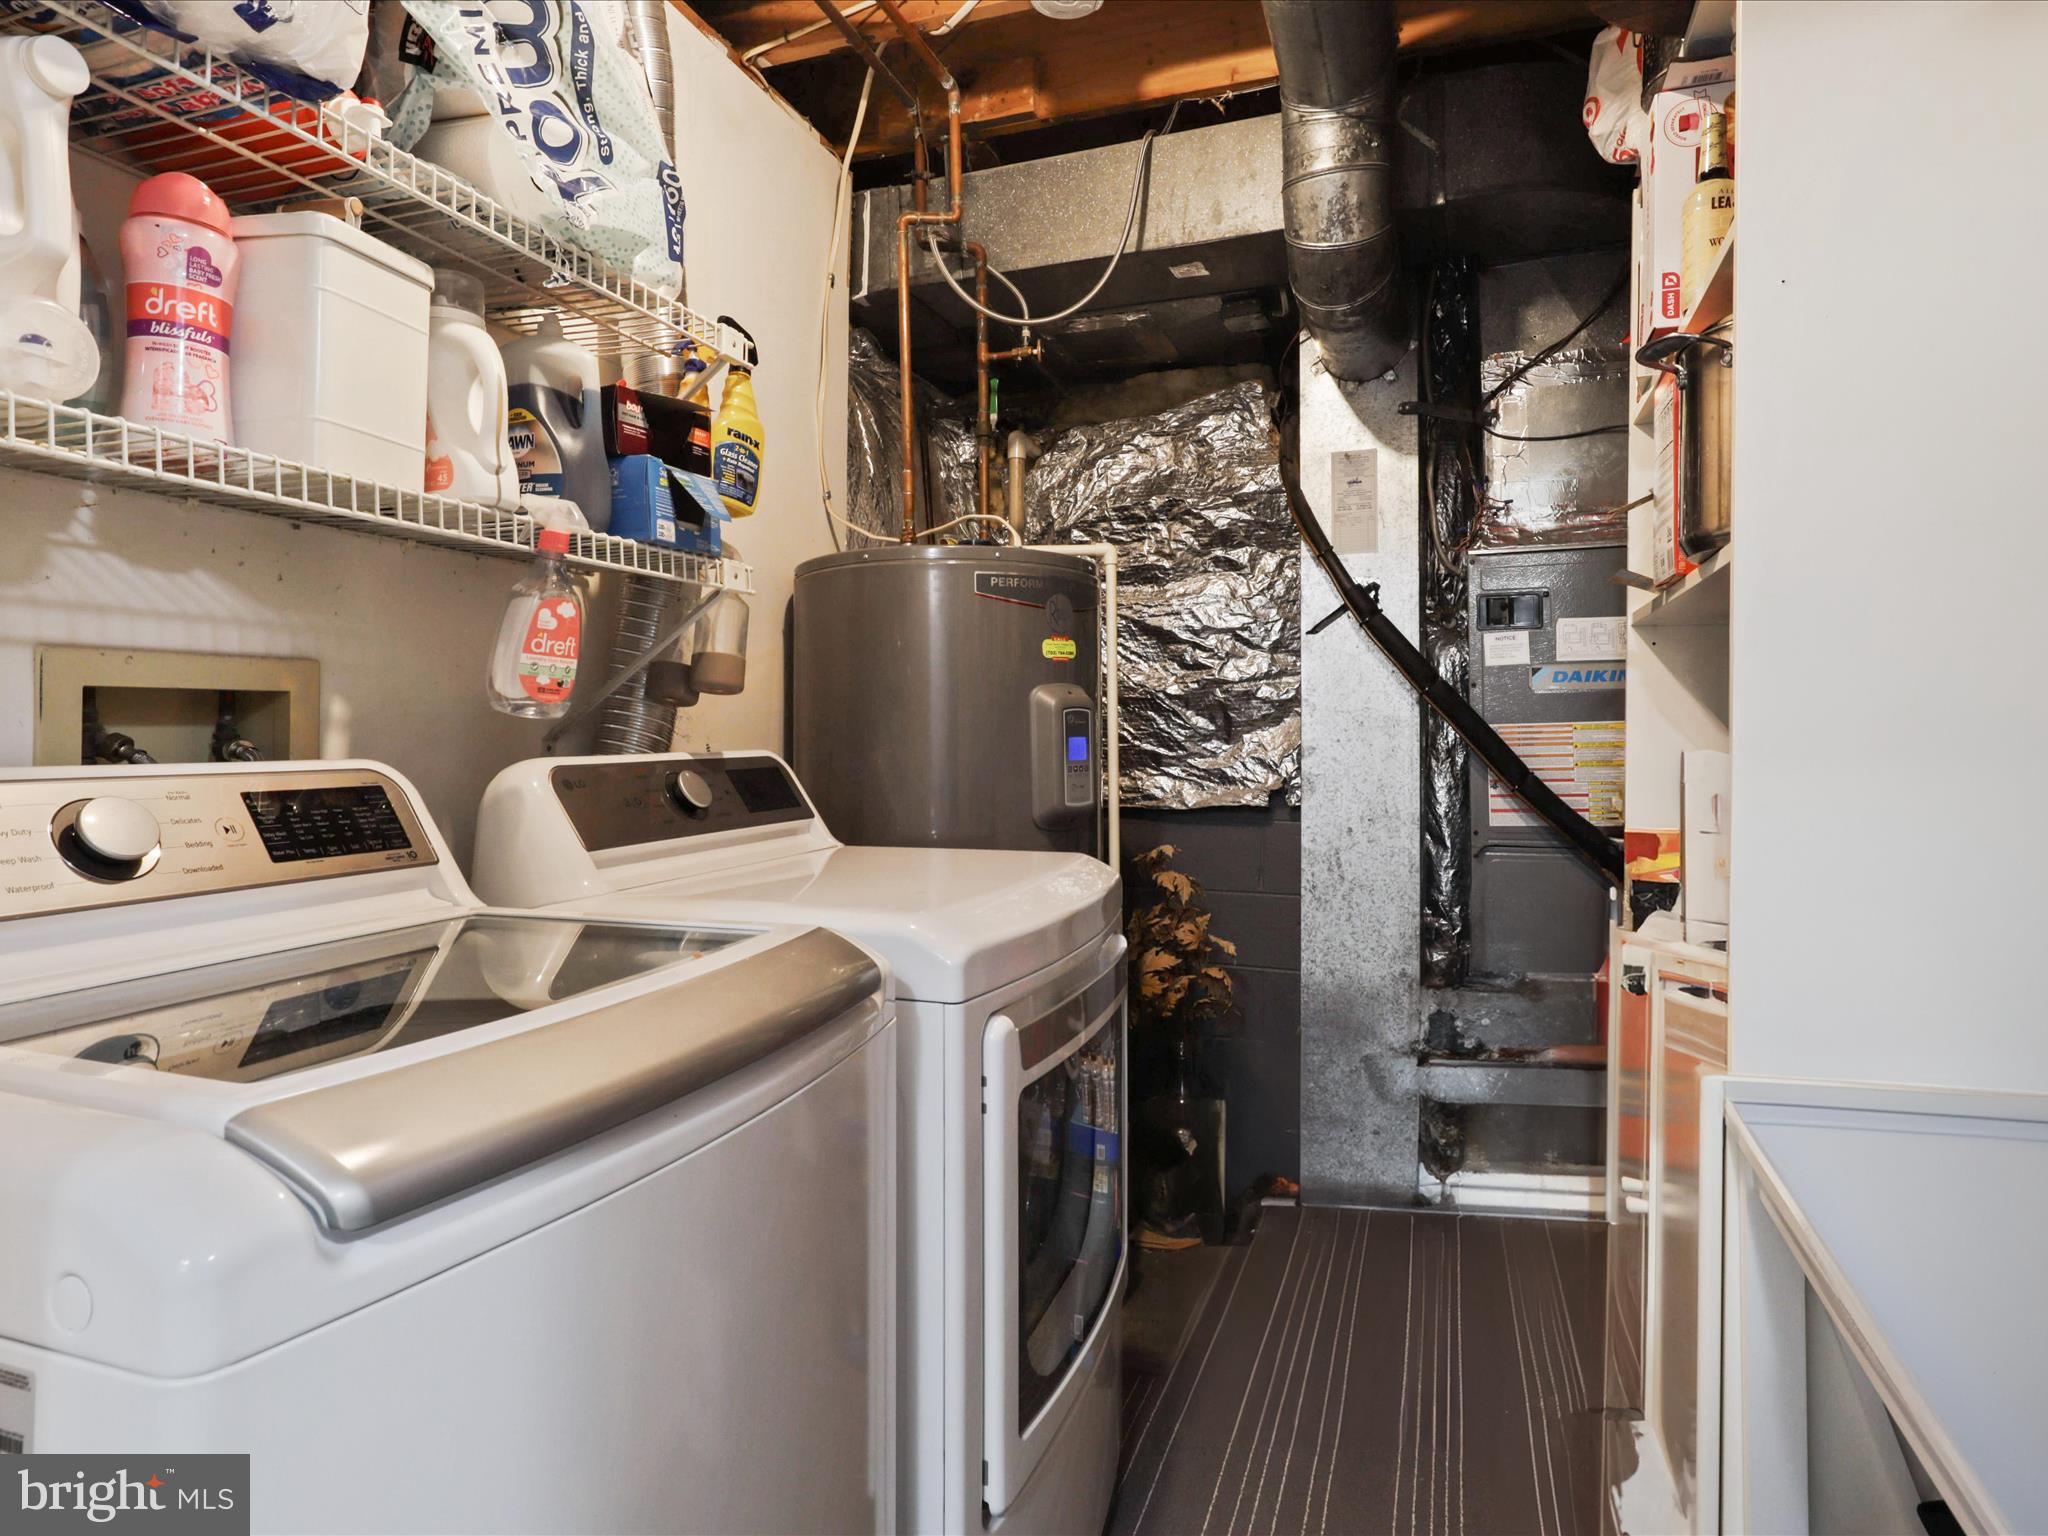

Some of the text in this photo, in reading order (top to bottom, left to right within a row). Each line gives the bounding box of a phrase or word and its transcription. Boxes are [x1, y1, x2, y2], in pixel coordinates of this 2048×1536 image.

[573, 11, 610, 157] Strong, Thick and
[189, 256, 207, 265] LONG
[189, 262, 214, 274] LASTING
[188, 268, 222, 283] BABY FRESH
[188, 273, 208, 283] SCENT
[145, 288, 217, 328] dreft
[1667, 292, 1675, 317] DASH
[150, 321, 213, 343] blissfuls
[509, 433, 535, 450] AWN
[720, 448, 738, 460] Glass
[990, 576, 1042, 589] PERFORM
[531, 632, 576, 657] dreft
[170, 817, 202, 825] Delicates
[10, 827, 32, 838] Duty
[184, 840, 214, 849] Bedding
[0, 855, 42, 867] eep Wash
[182, 863, 224, 875] Downloaded
[5, 882, 55, 895] Waterproof
